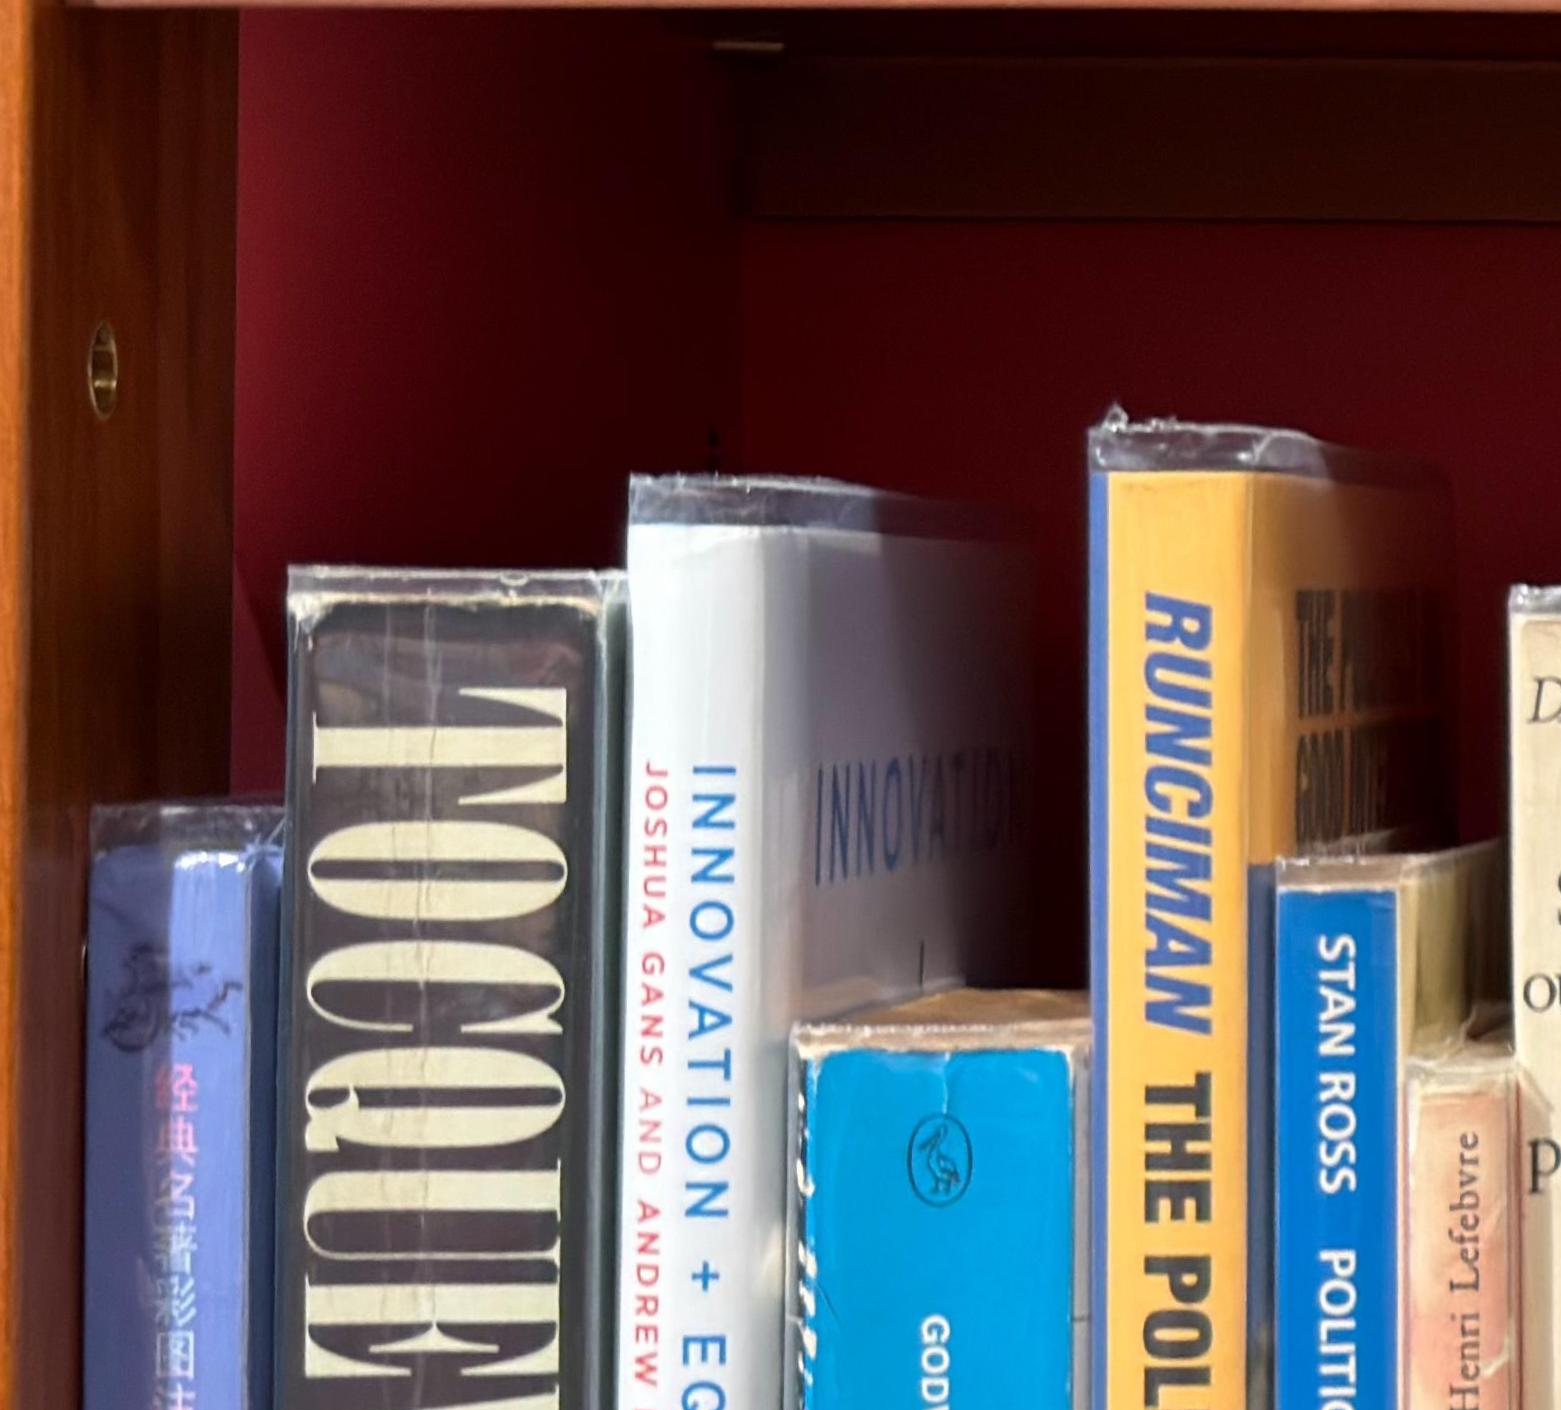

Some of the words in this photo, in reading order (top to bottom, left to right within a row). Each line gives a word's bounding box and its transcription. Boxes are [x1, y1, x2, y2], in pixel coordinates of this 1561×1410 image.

[642, 762, 668, 929] JOSHUA
[1144, 591, 1213, 1035] RUNCIMAN
[639, 952, 665, 1067] GANS
[685, 764, 737, 1218] INNOVATION
[1319, 934, 1356, 1056] STAN
[1319, 1073, 1356, 1194] ROSS
[1450, 1130, 1481, 1292] Lefebvre
[634, 1201, 660, 1386] ANDREW
